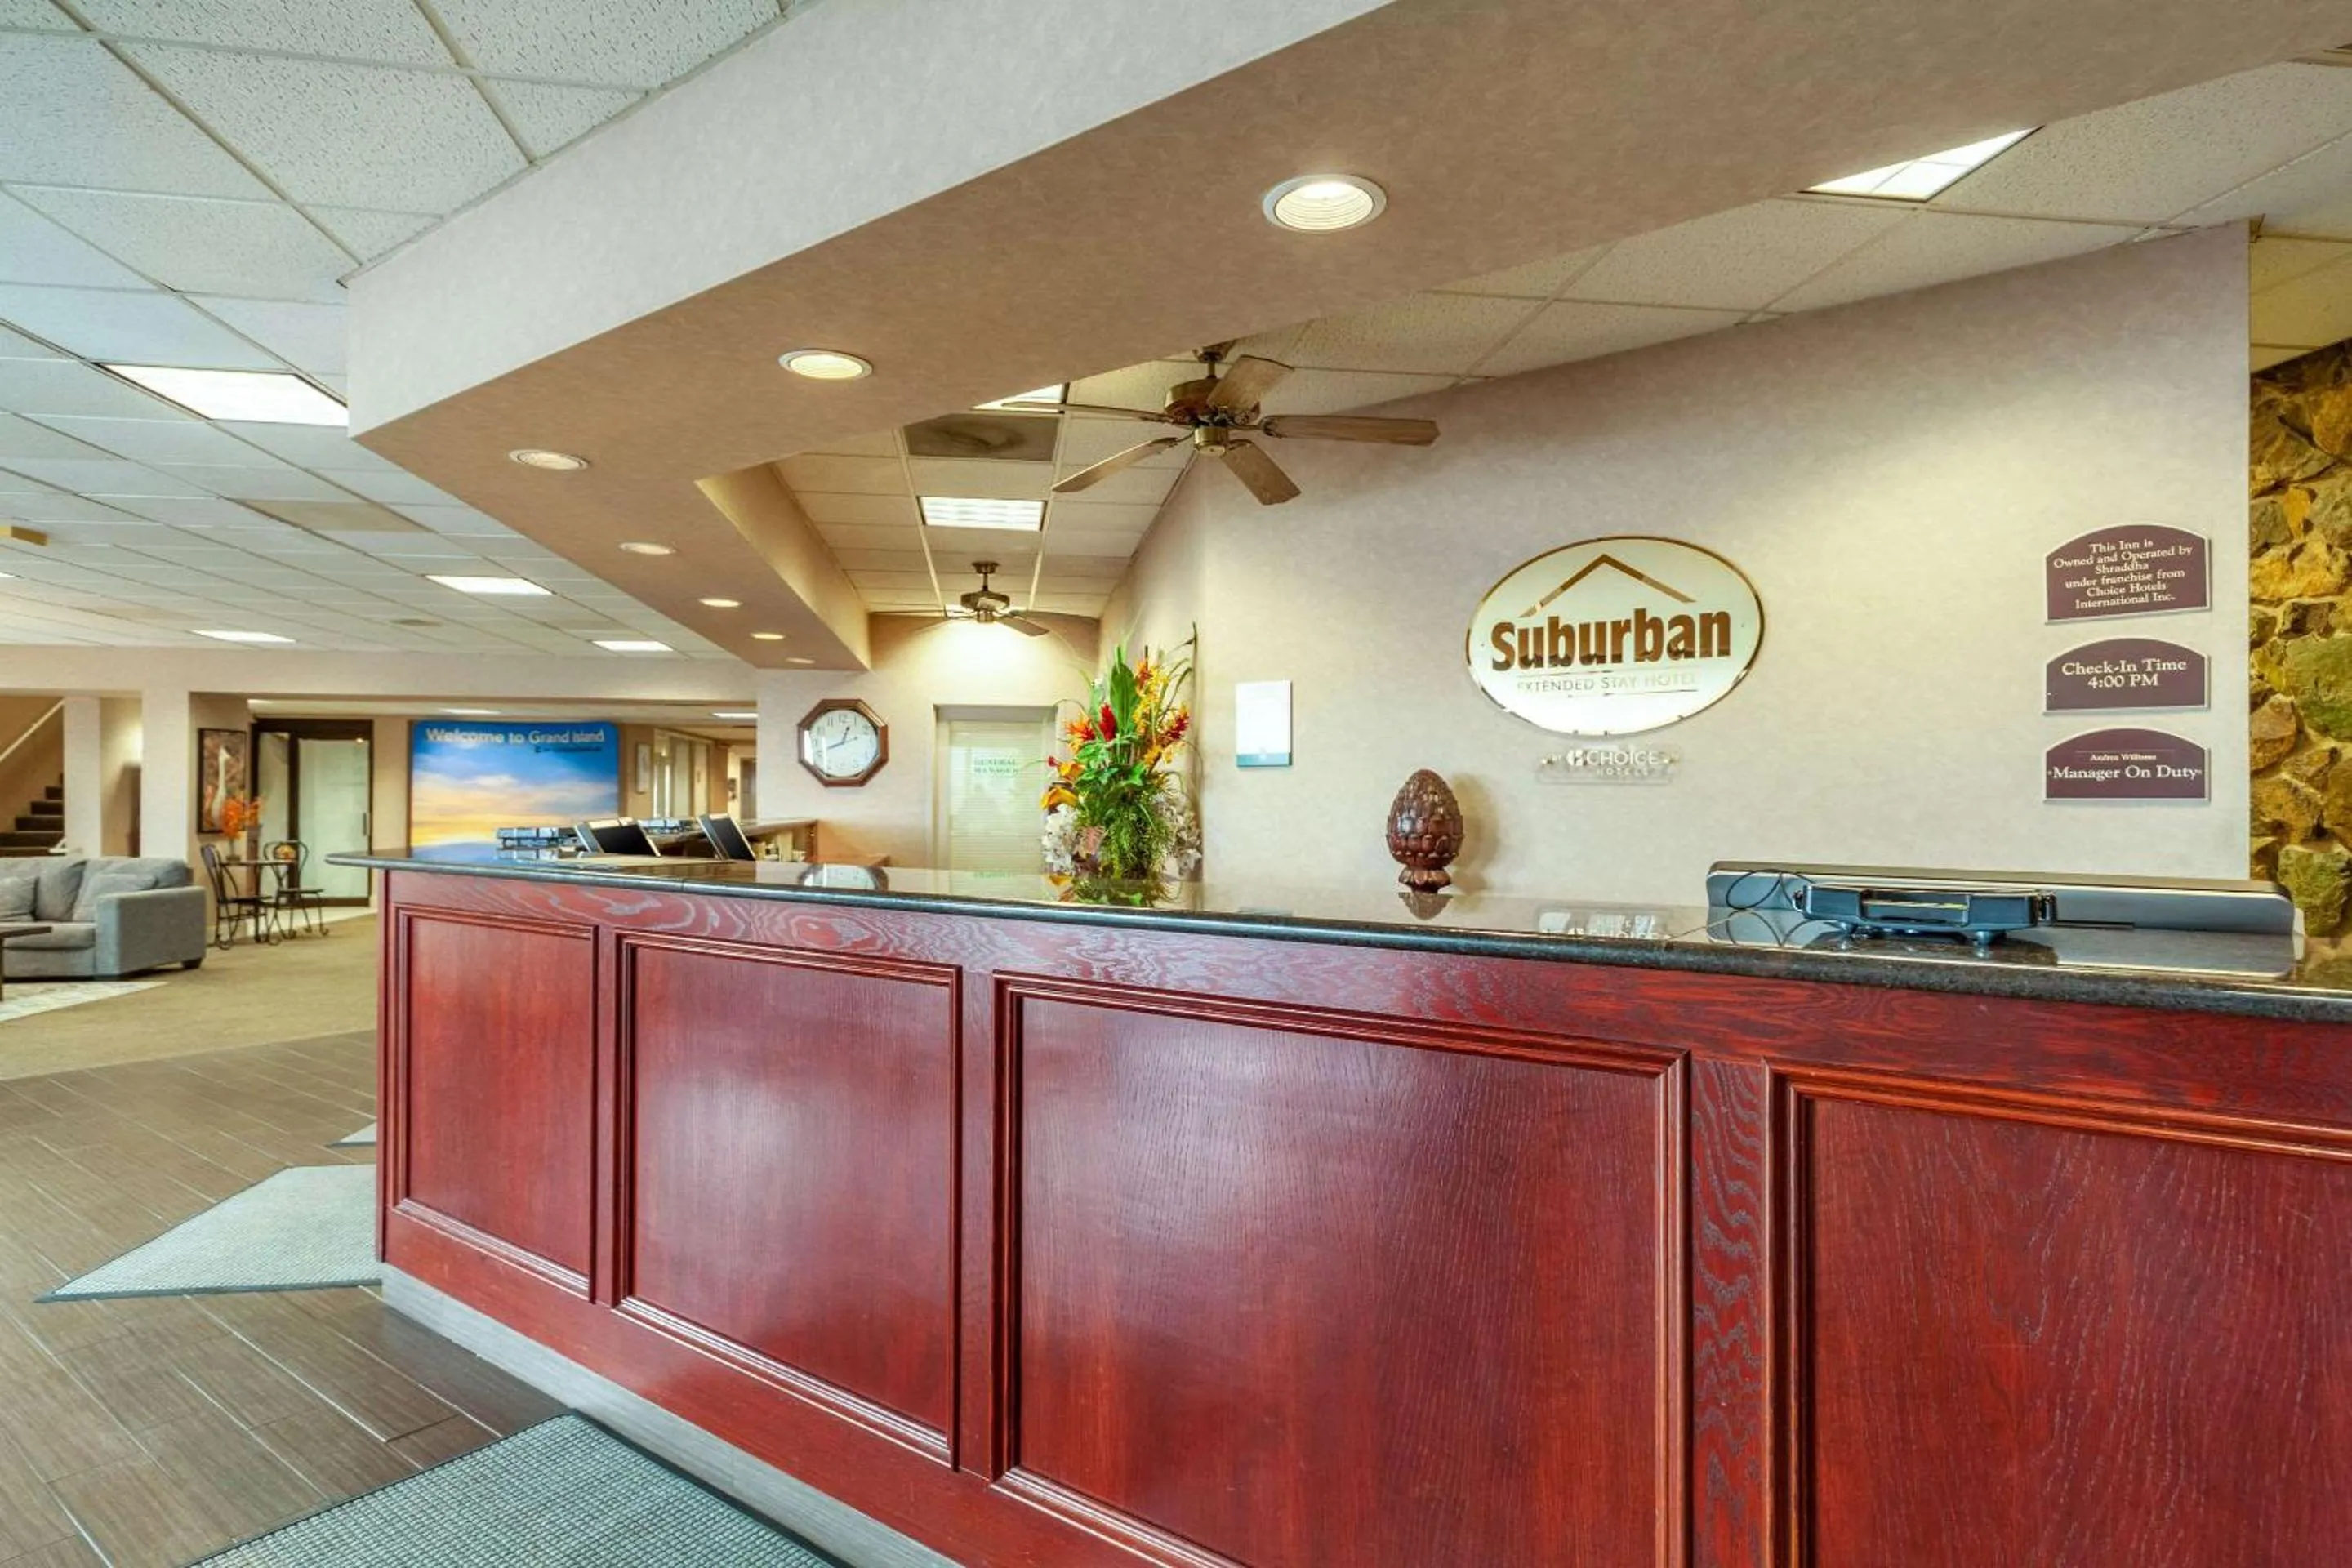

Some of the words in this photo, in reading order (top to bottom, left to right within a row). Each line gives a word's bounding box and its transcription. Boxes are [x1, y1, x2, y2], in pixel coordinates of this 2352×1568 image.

[2090, 543, 2116, 554] This
[2119, 541, 2140, 550] Inn
[2144, 539, 2154, 547] is
[2053, 556, 2094, 568] Owned
[2097, 555, 2118, 564] and
[2121, 549, 2176, 561] Operated
[2178, 546, 2193, 556] by
[2095, 562, 2149, 575] Shraddha
[2065, 580, 2097, 589] under
[2101, 573, 2152, 586] franchise
[2157, 569, 2185, 579] from
[2087, 587, 2126, 597] Choice
[2130, 581, 2166, 593] Hotels
[2075, 593, 2149, 609] International
[1491, 608, 1731, 671] Suburban
[2061, 659, 2137, 676] Check-In
[2141, 658, 2187, 671] Time
[1517, 677, 1594, 692] EXTENDED
[1601, 676, 1637, 689] STAY
[2087, 675, 2124, 689] 4:00
[2130, 673, 2159, 687] PM
[426, 728, 504, 742] Welcome
[509, 731, 524, 744] to
[528, 730, 570, 743] Grand
[572, 729, 605, 742] Island
[1586, 750, 1659, 765] CHOICE
[2053, 766, 2121, 781] Manager
[2125, 765, 2150, 778] On
[2156, 764, 2198, 780] Duty
